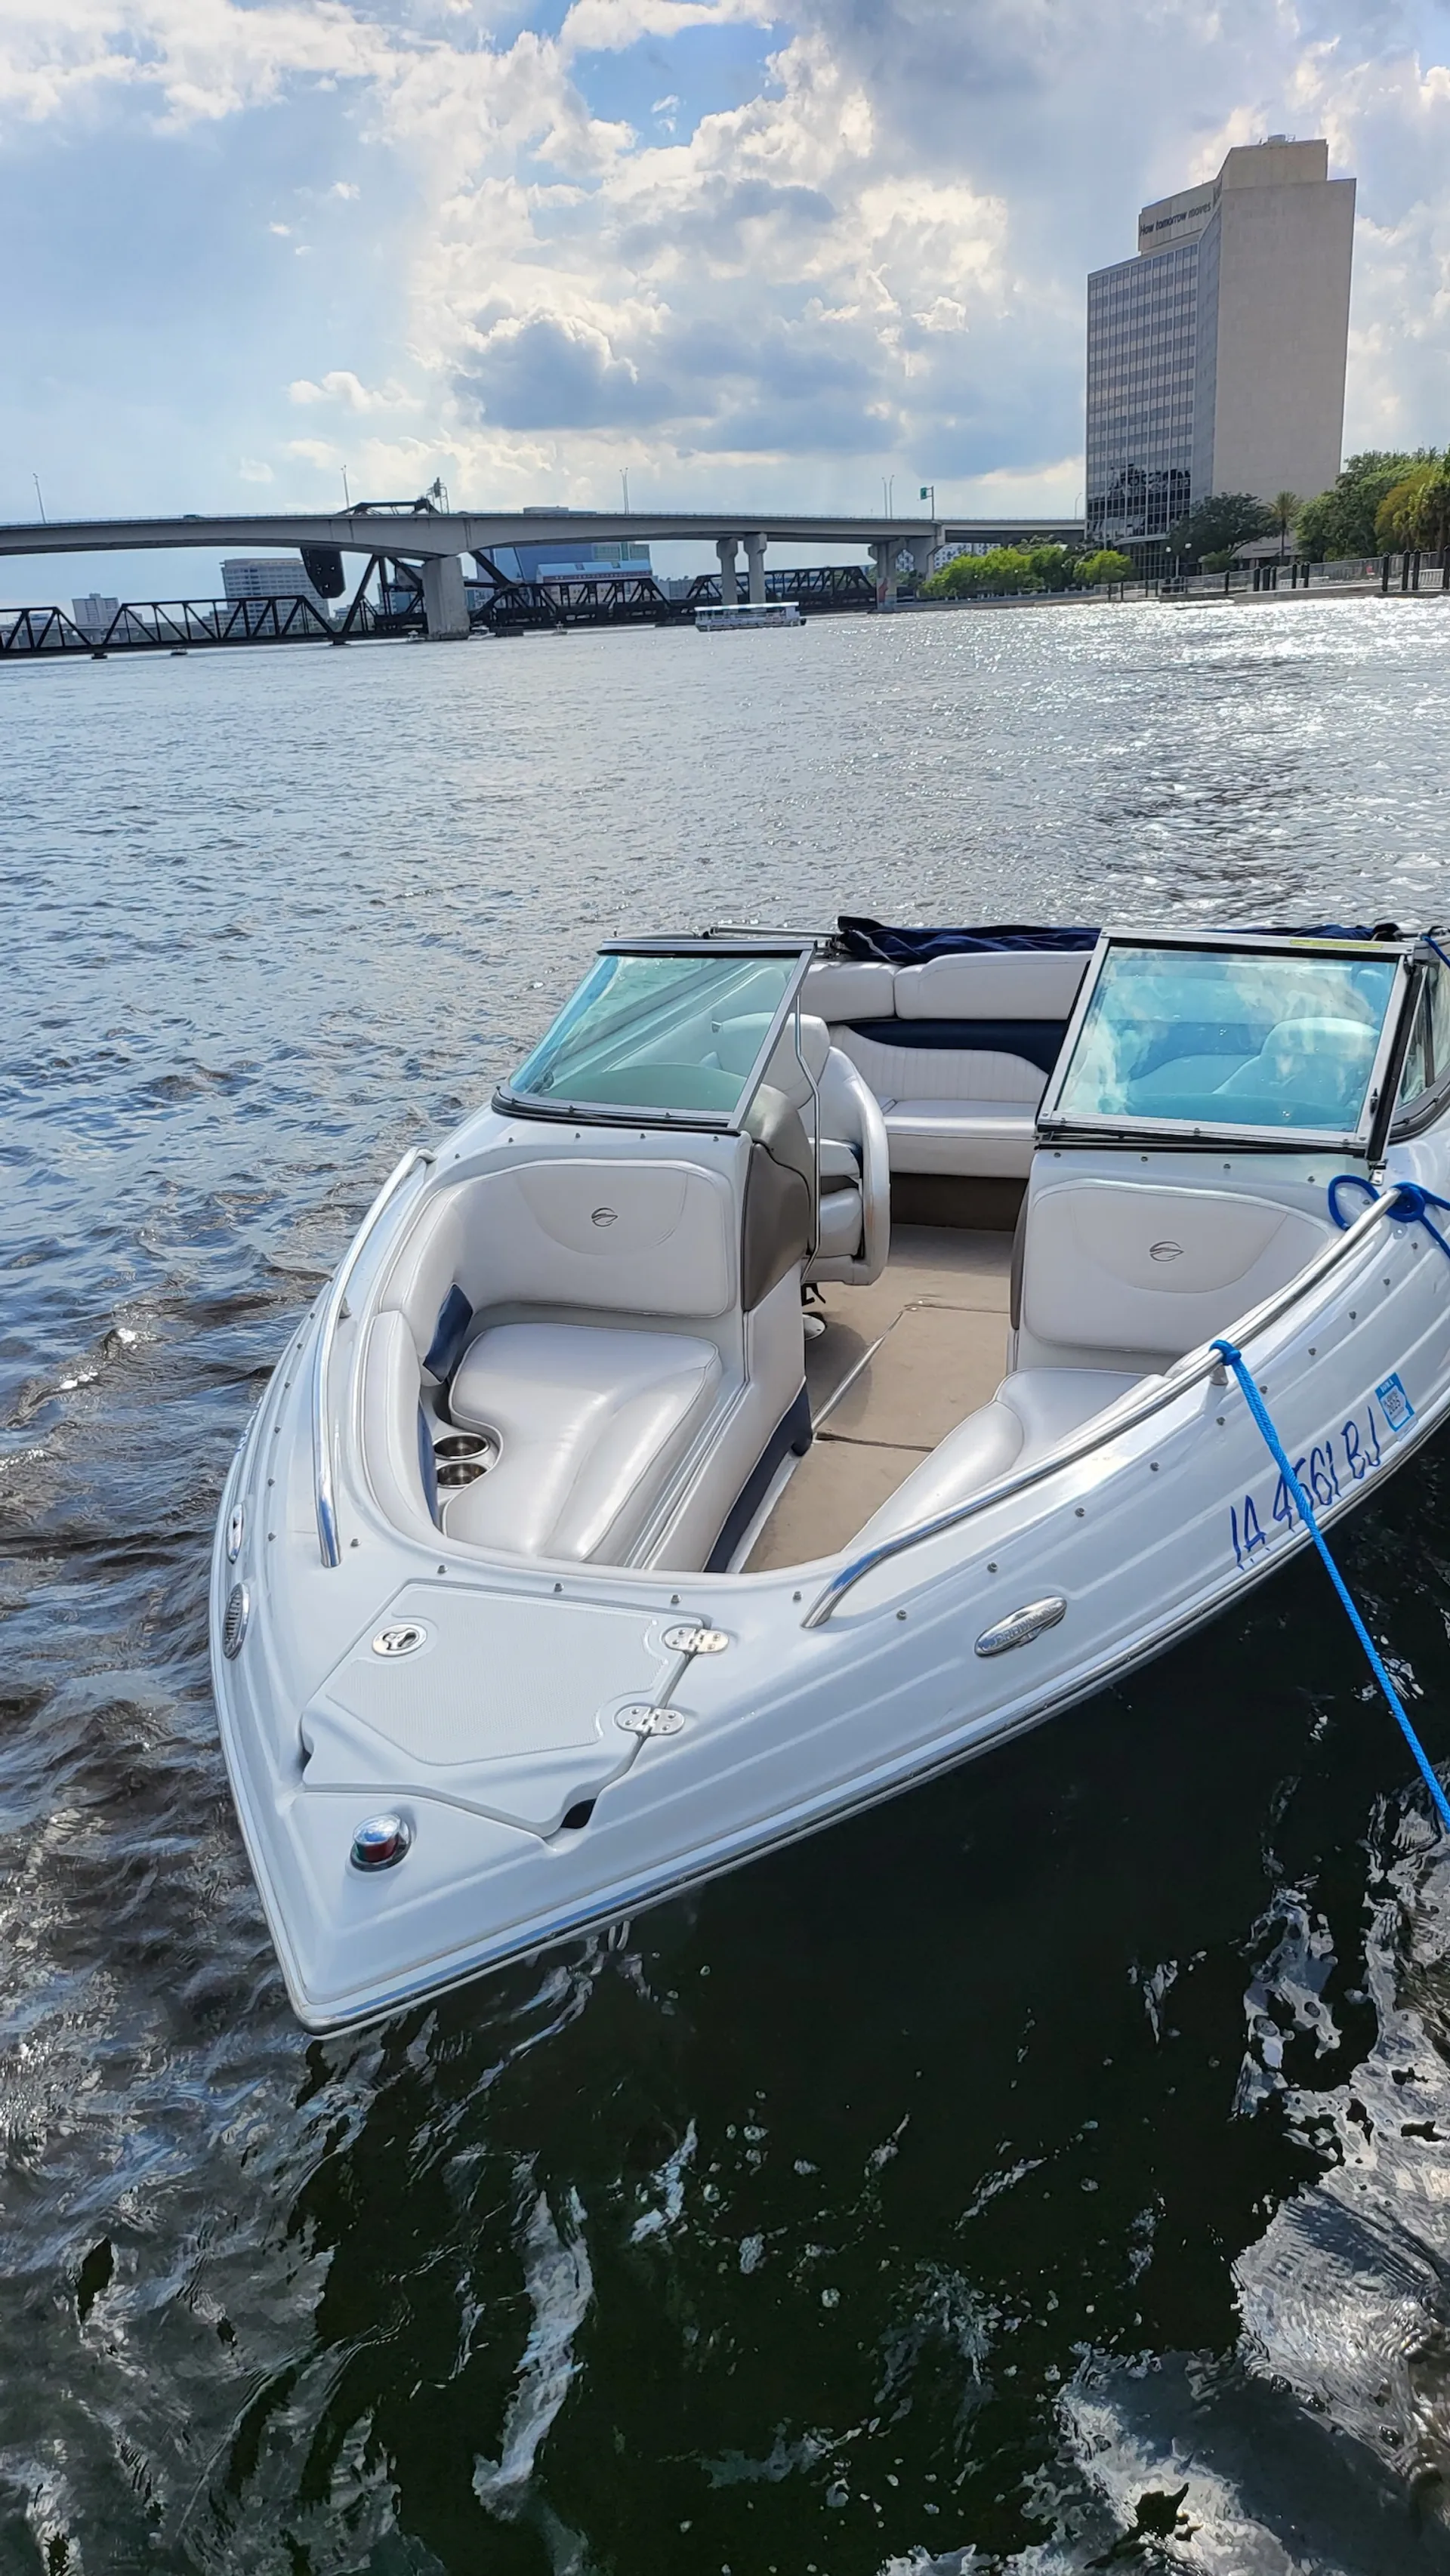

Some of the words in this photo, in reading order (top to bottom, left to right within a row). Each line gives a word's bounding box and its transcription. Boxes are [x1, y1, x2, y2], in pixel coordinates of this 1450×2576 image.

[1139, 224, 1155, 236] How
[1155, 211, 1187, 231] tomorrow
[1188, 202, 1212, 219] moves
[1340, 1405, 1381, 1479] BJ
